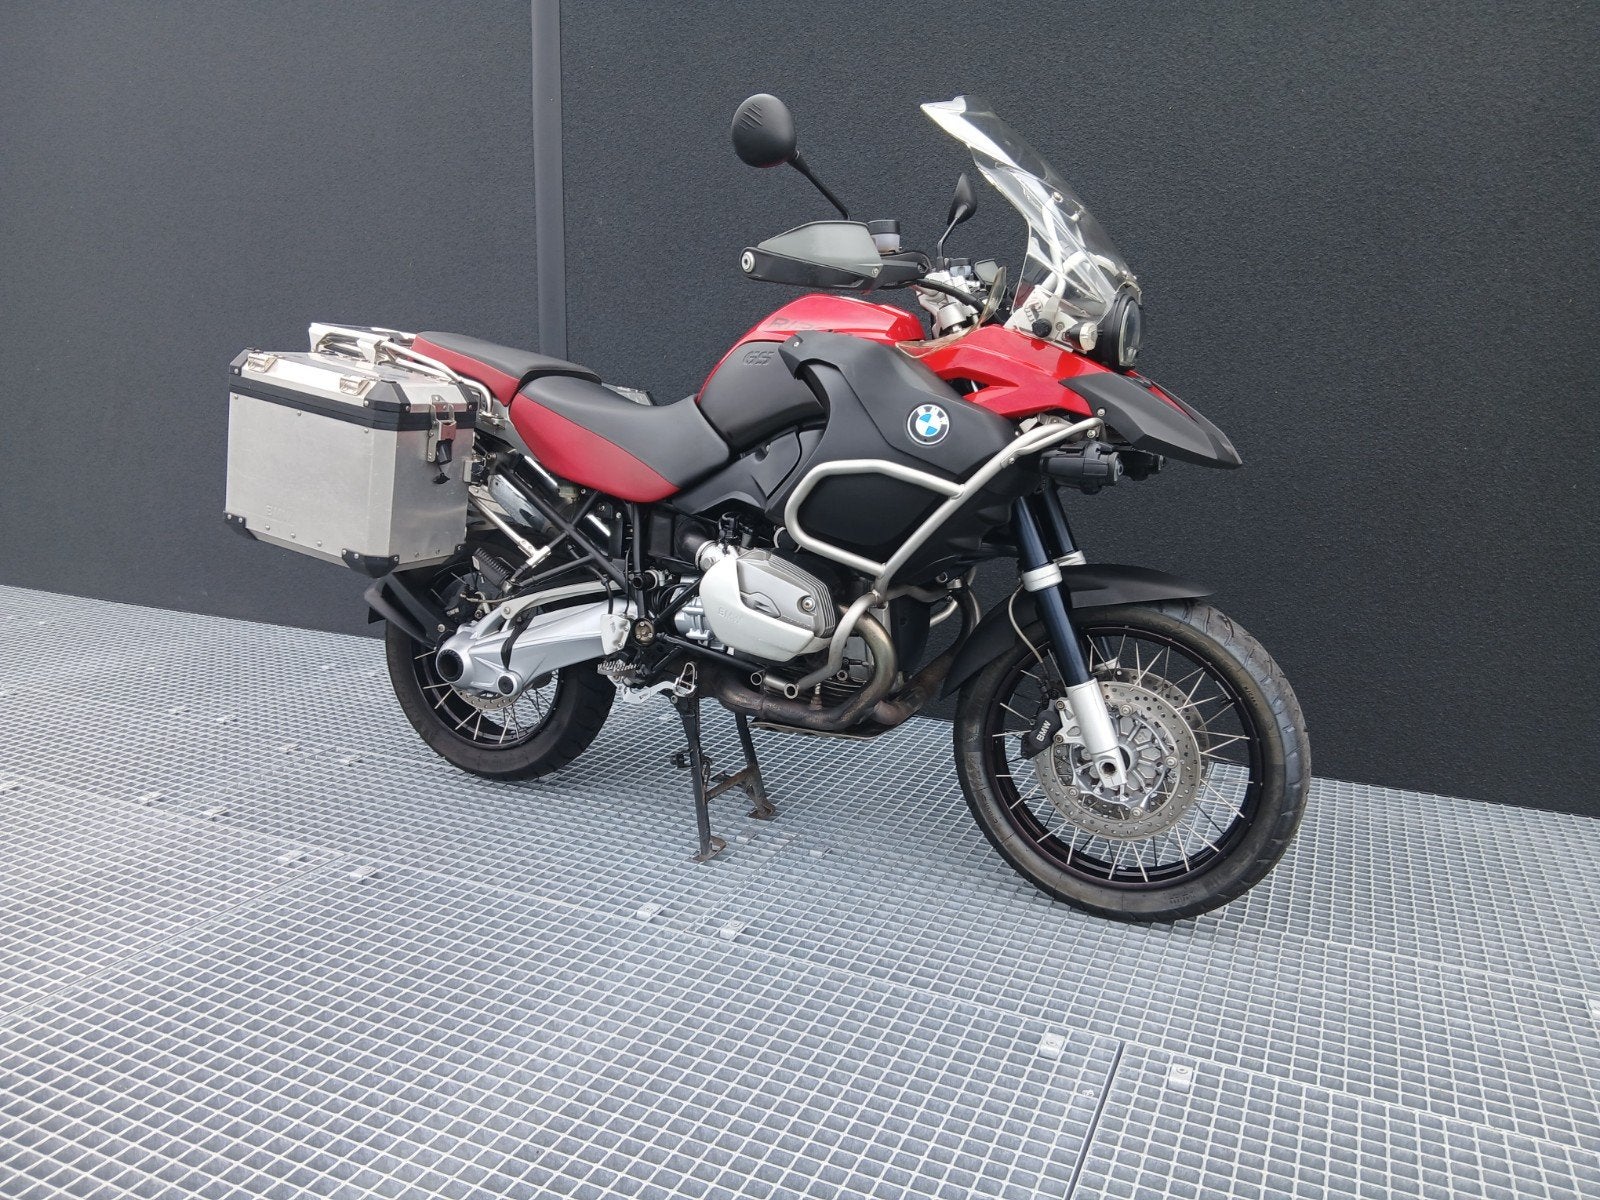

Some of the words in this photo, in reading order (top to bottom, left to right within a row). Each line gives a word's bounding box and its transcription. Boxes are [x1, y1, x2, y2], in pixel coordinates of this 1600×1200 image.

[743, 351, 775, 366] GS
[916, 405, 949, 425] BMW
[1036, 720, 1051, 742] BMW
